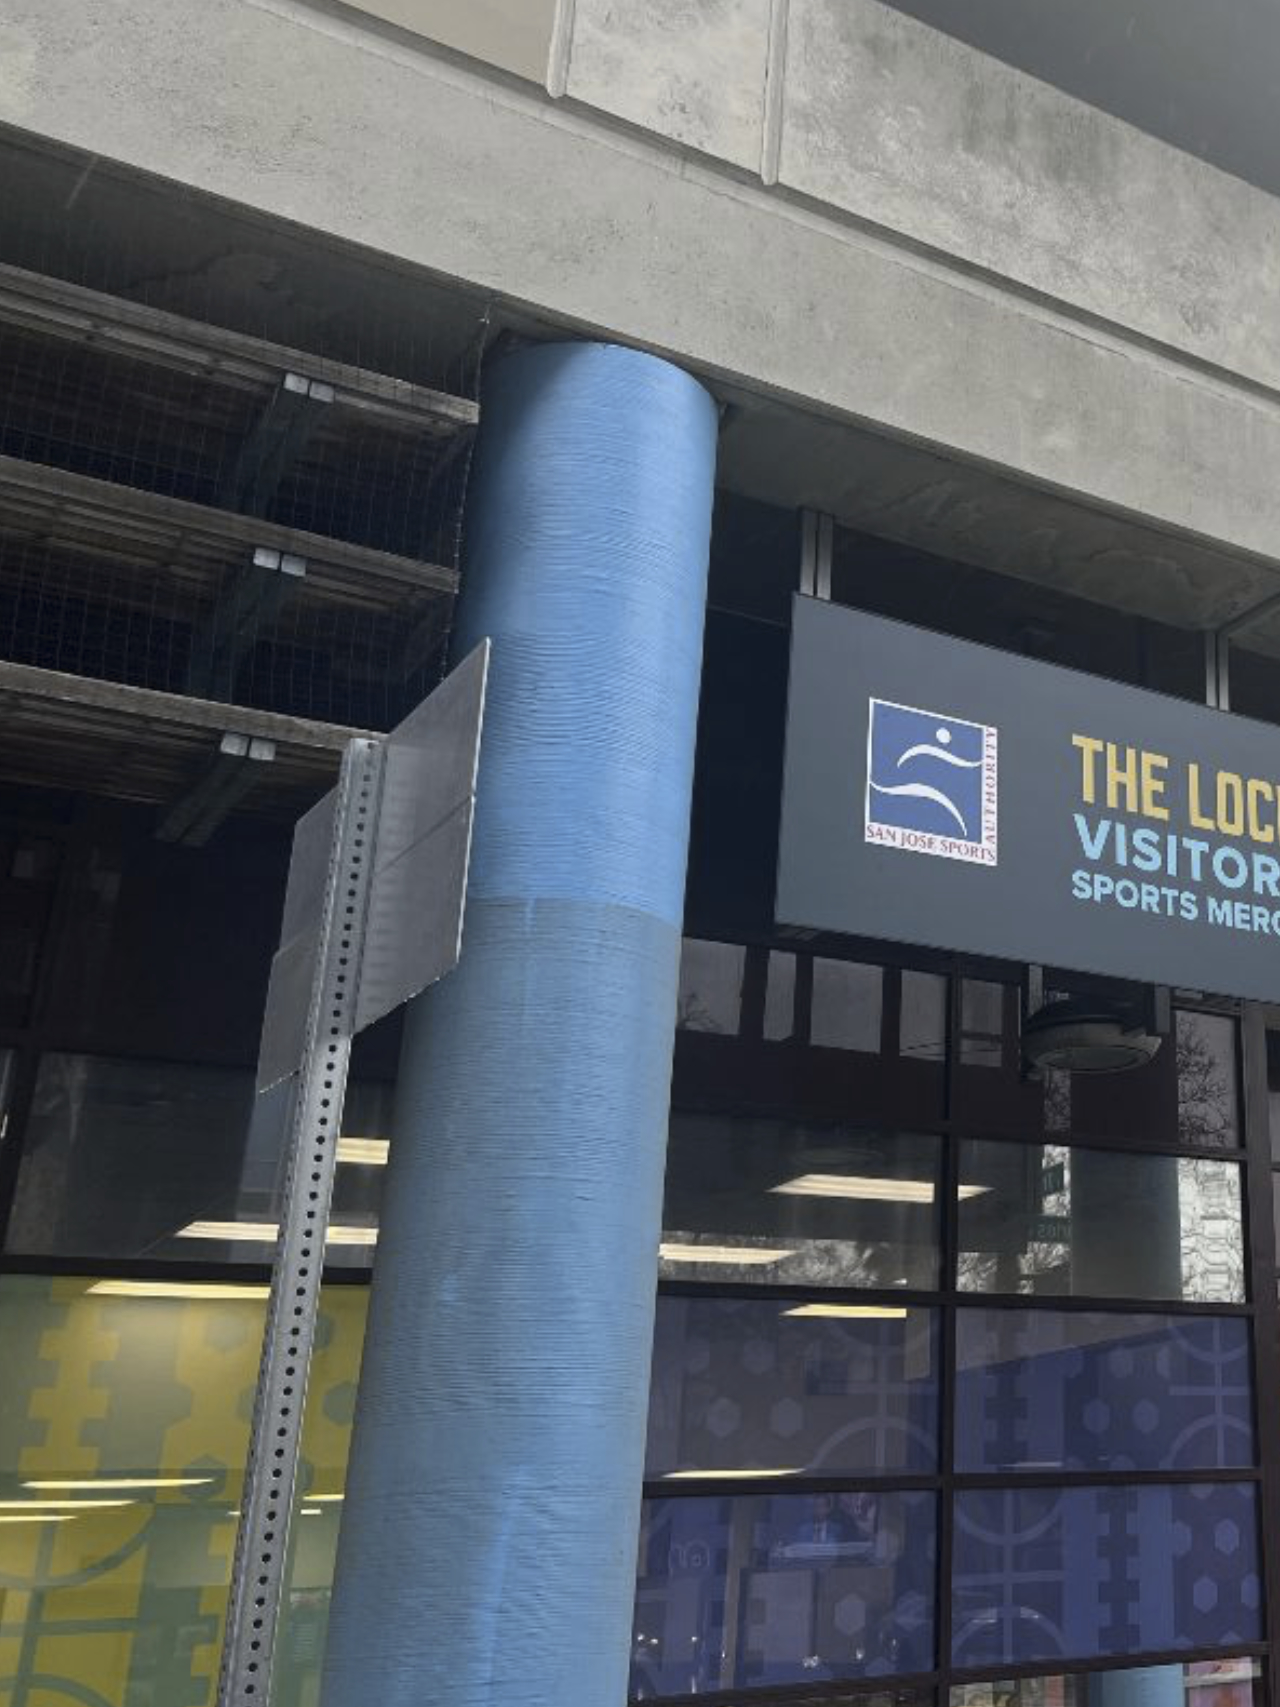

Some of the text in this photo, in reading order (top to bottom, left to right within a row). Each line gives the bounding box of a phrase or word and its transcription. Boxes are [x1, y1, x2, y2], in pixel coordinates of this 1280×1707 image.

[985, 728, 996, 844] AUTHORITY
[1072, 734, 1170, 821] THE
[867, 825, 996, 863] SAN JOSE SPORTS
[1072, 869, 1198, 921] SPORTS
